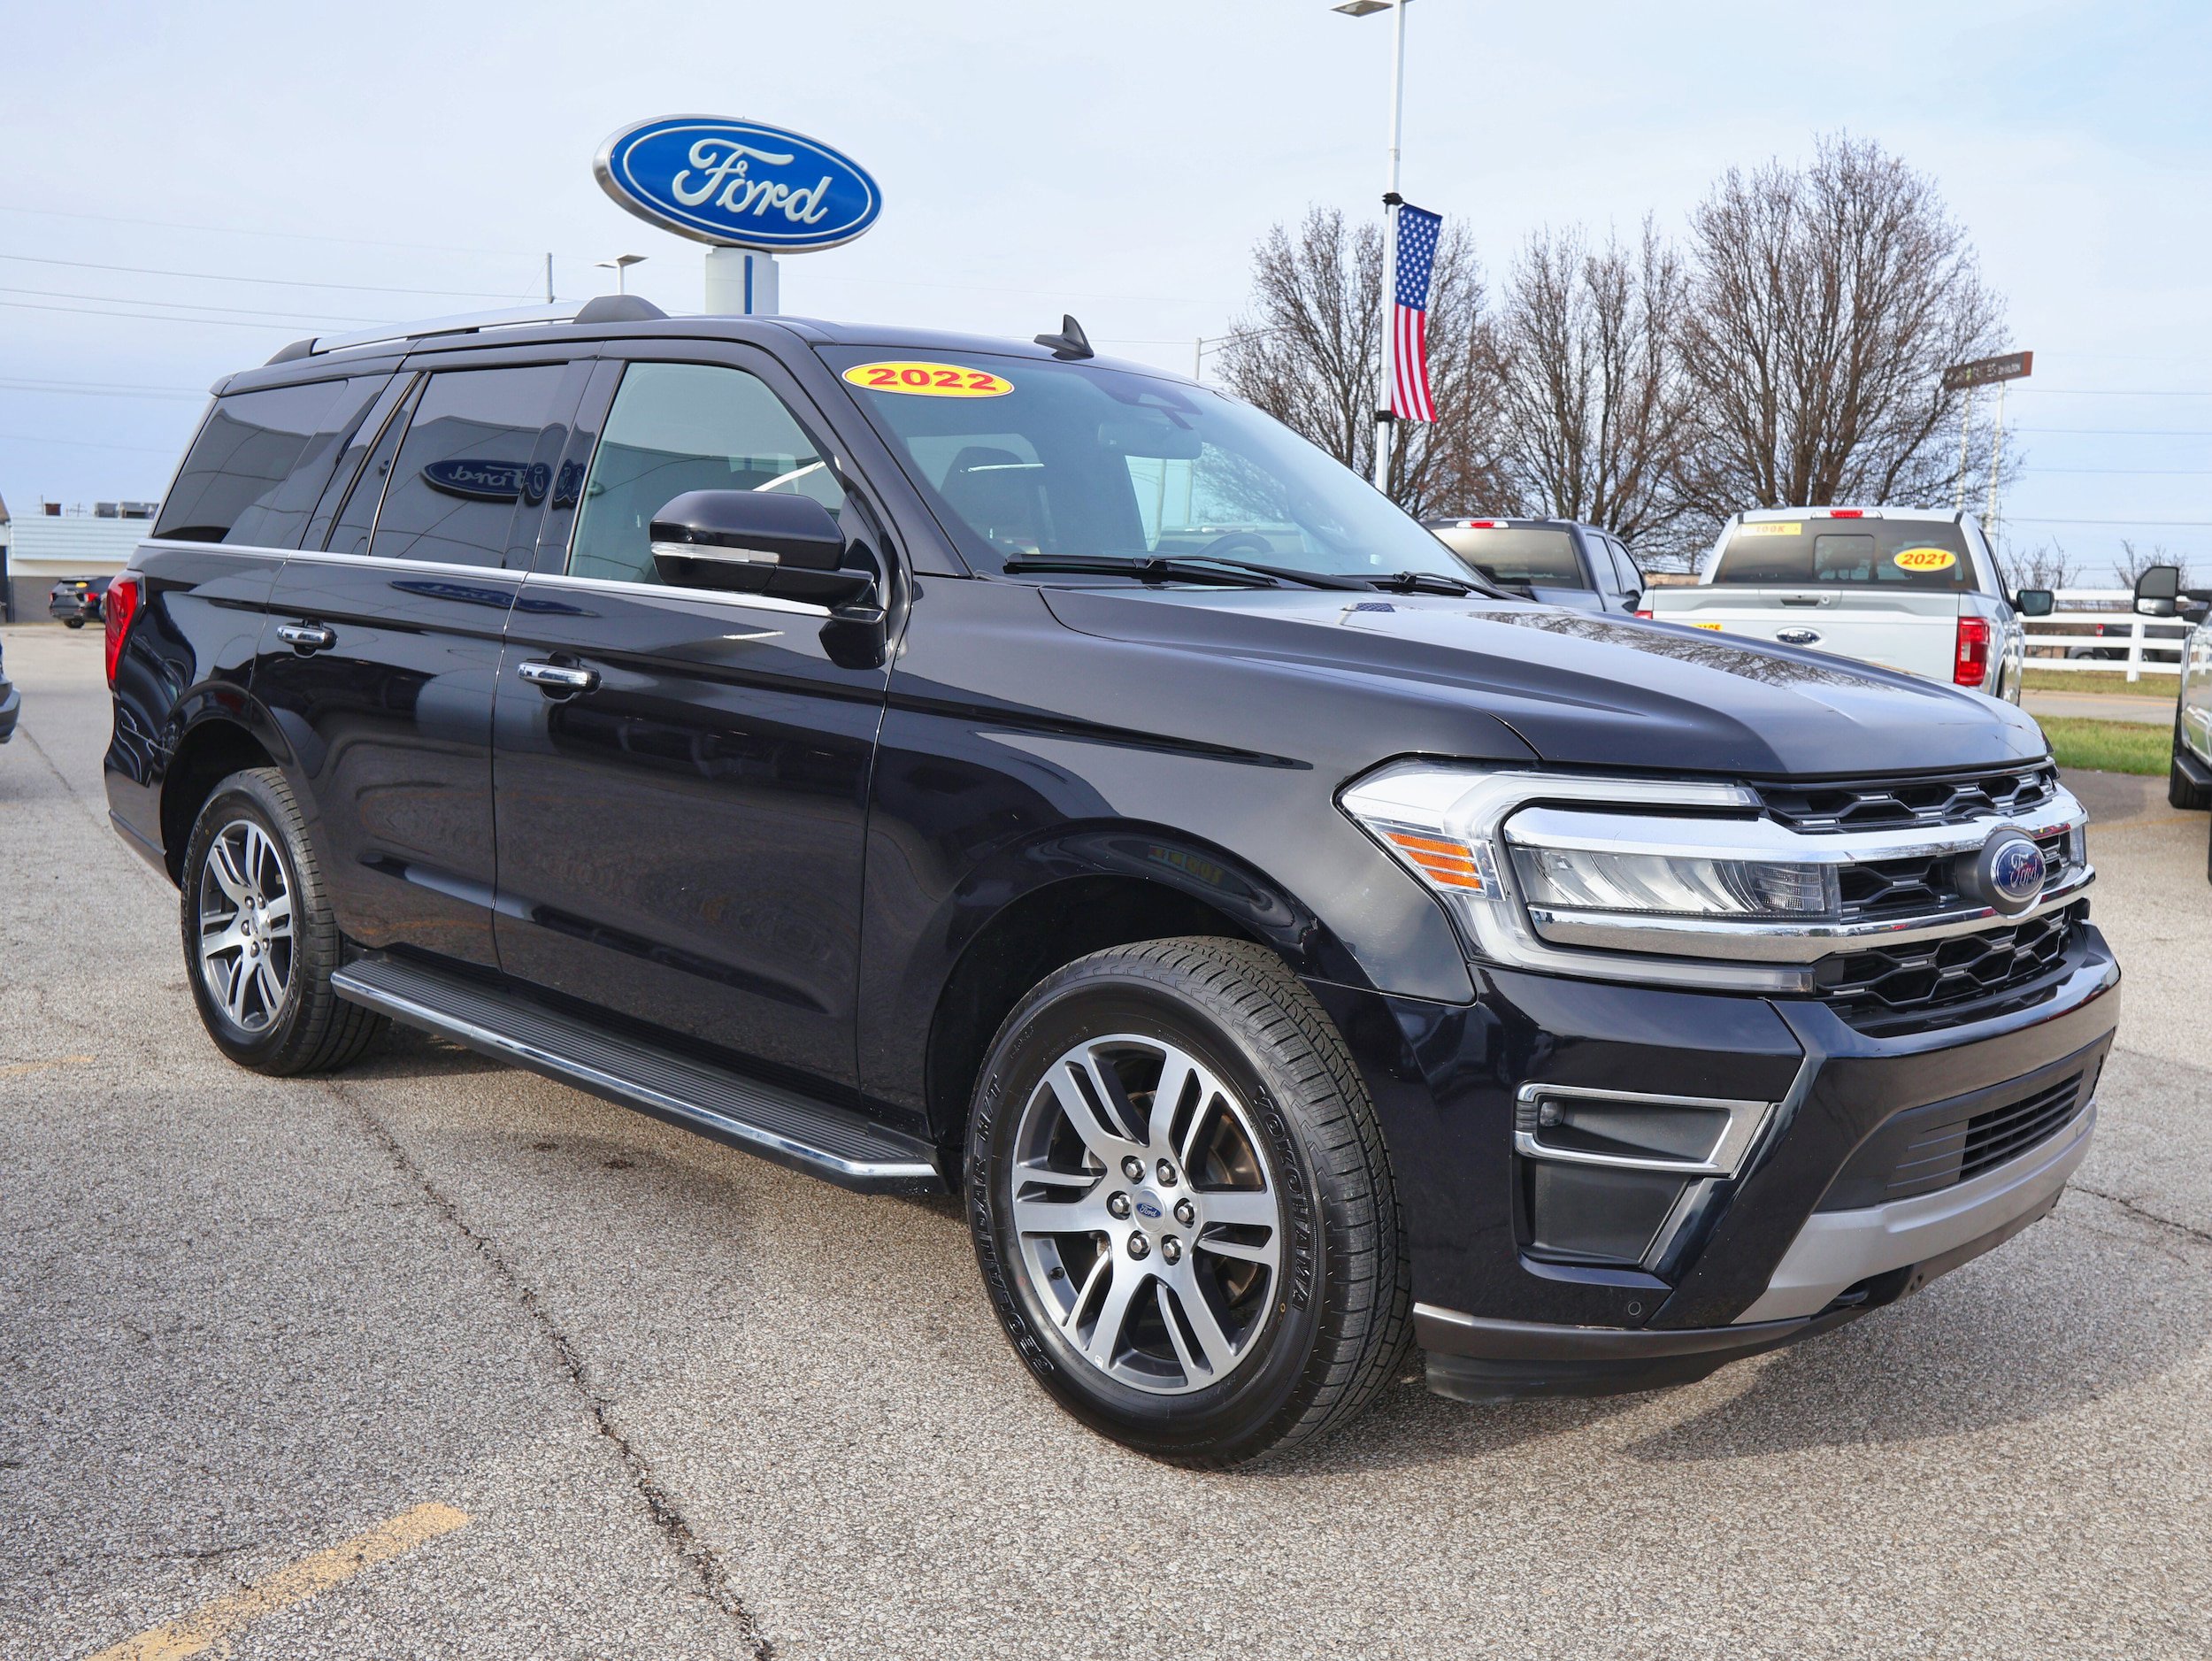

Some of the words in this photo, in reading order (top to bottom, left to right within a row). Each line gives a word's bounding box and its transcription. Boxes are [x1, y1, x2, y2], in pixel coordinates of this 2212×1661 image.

[672, 138, 833, 224] Ford
[867, 368, 997, 393] 2022
[1901, 553, 1947, 565] 2021
[2010, 853, 2039, 888] Ford
[1140, 1204, 1157, 1217] Ford
[1255, 1085, 1310, 1311] YOKOHAMA
[972, 1153, 1055, 1375] GEOLANDAR
